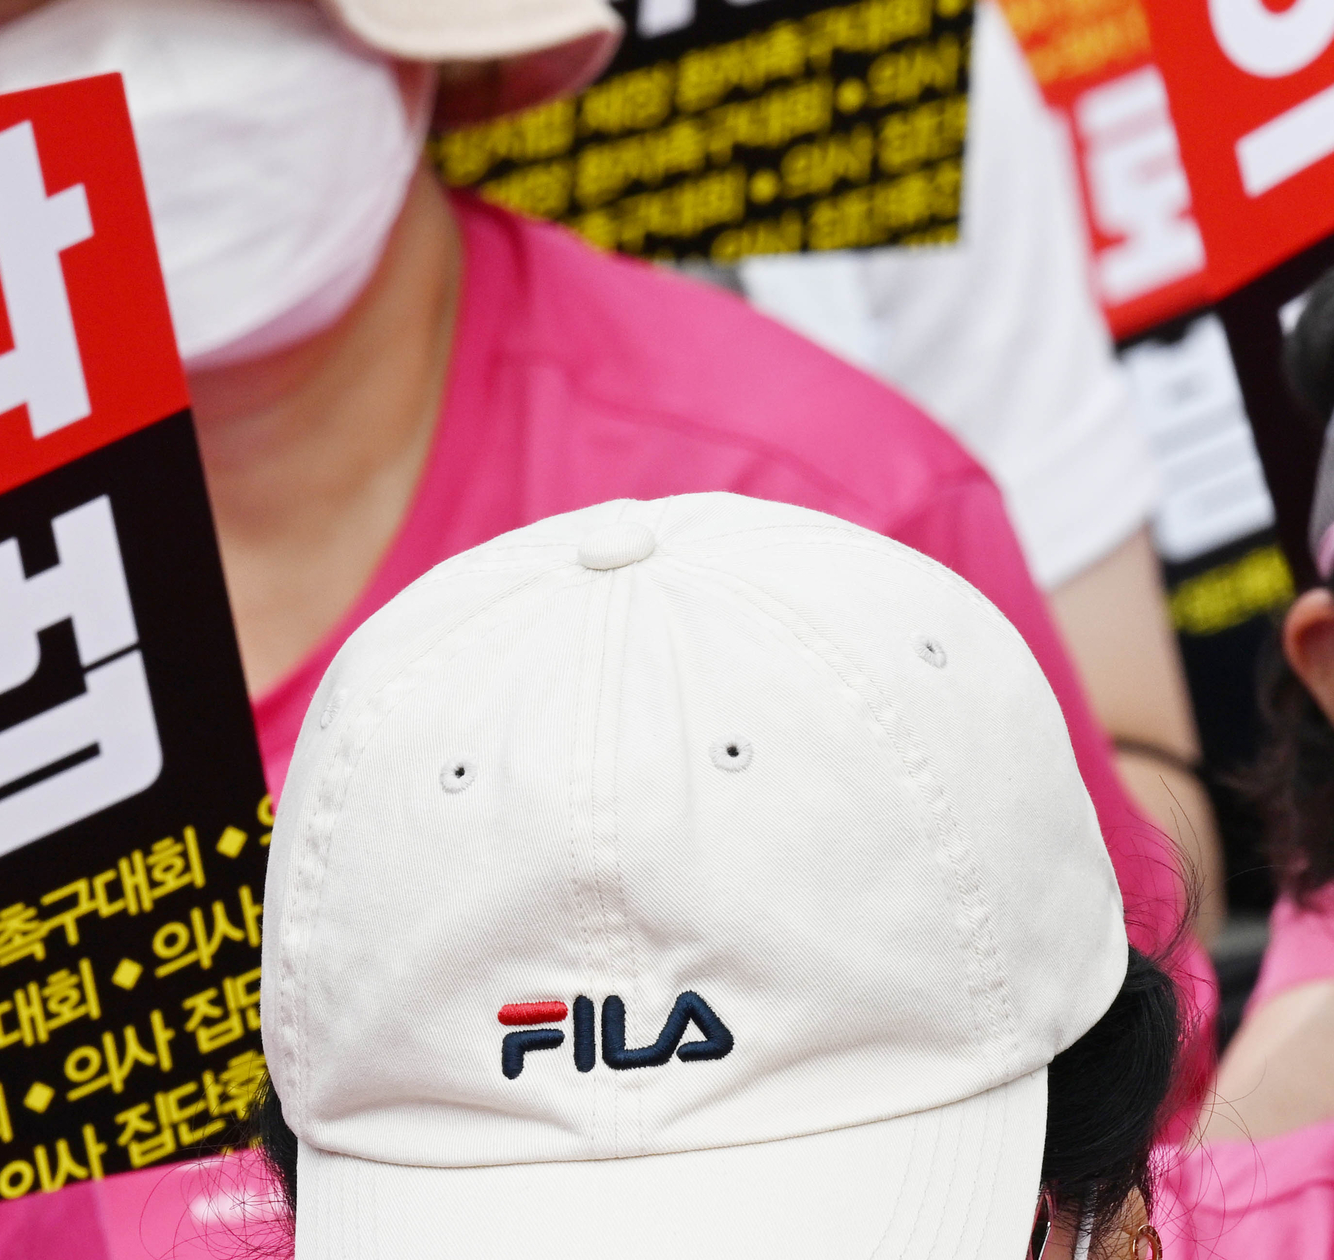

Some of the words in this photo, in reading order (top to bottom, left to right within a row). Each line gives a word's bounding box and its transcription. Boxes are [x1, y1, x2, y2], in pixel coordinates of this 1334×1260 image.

[152, 885, 264, 979] 의사
[63, 1009, 176, 1101] 의사
[497, 990, 735, 1080] FILA
